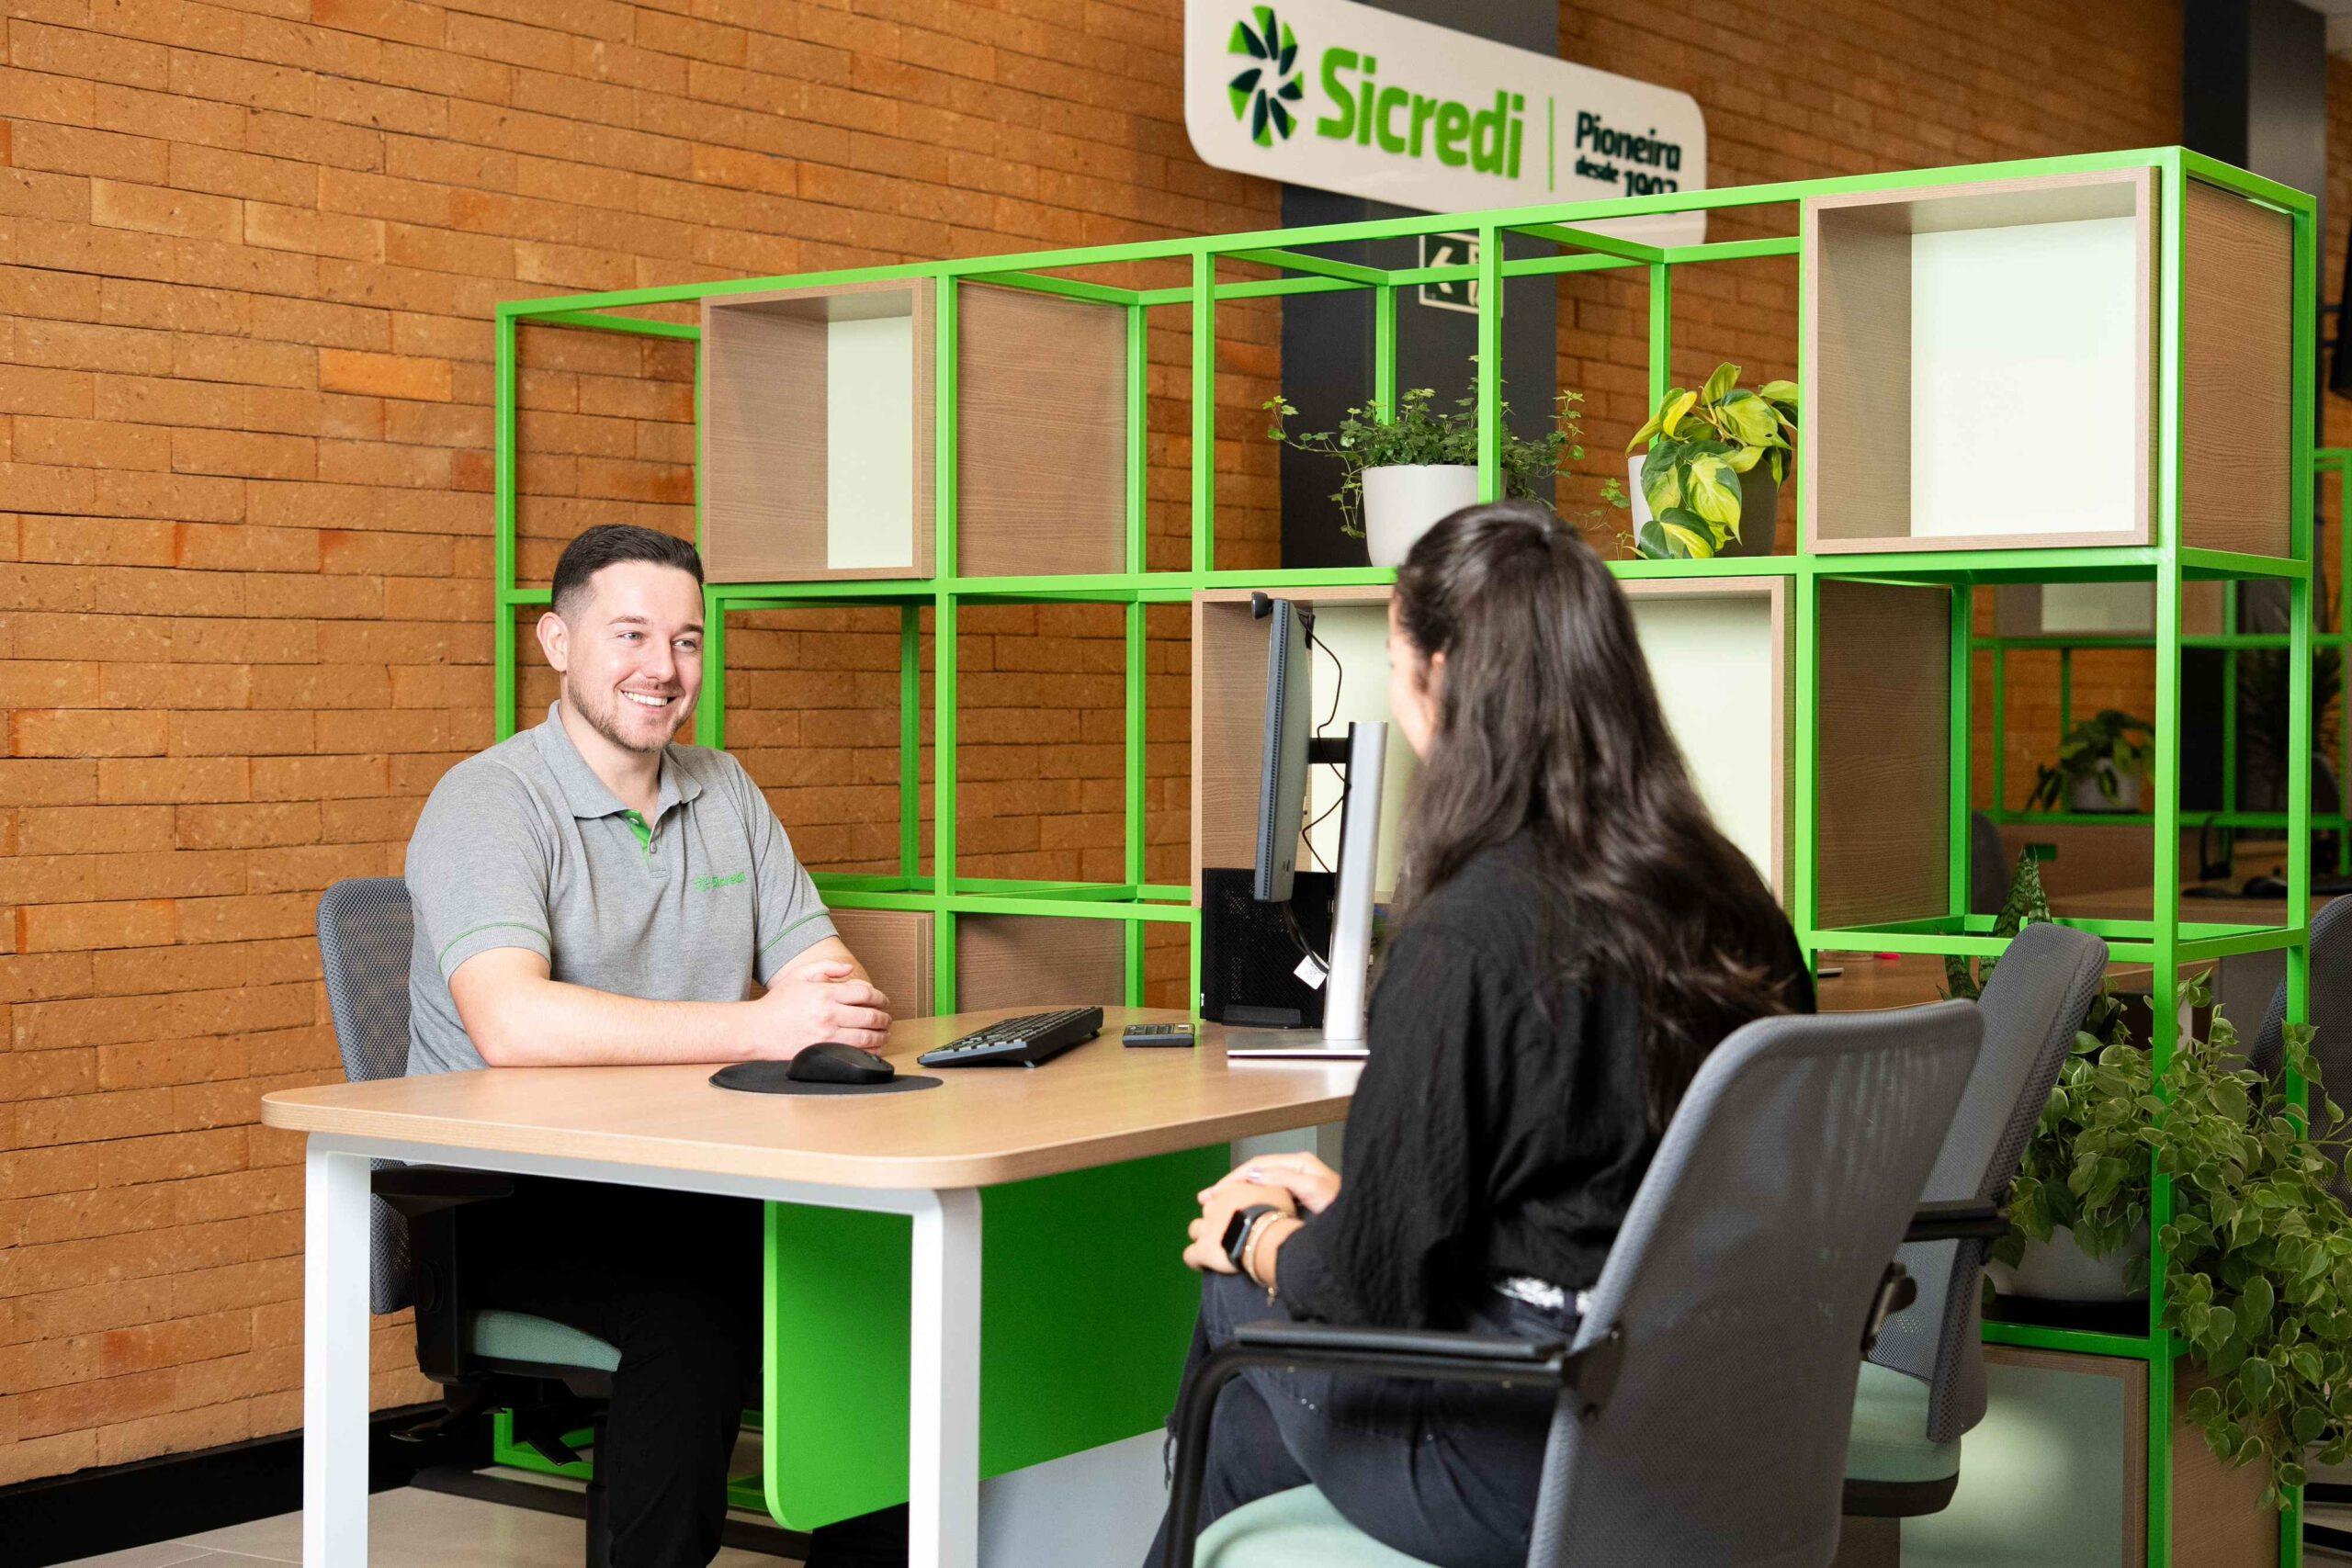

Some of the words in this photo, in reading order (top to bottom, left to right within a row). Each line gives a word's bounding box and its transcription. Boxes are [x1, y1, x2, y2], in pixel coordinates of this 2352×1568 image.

[1317, 47, 1526, 180] Sicredi
[1575, 110, 1681, 172] Pioneira
[1575, 154, 1620, 184] desde
